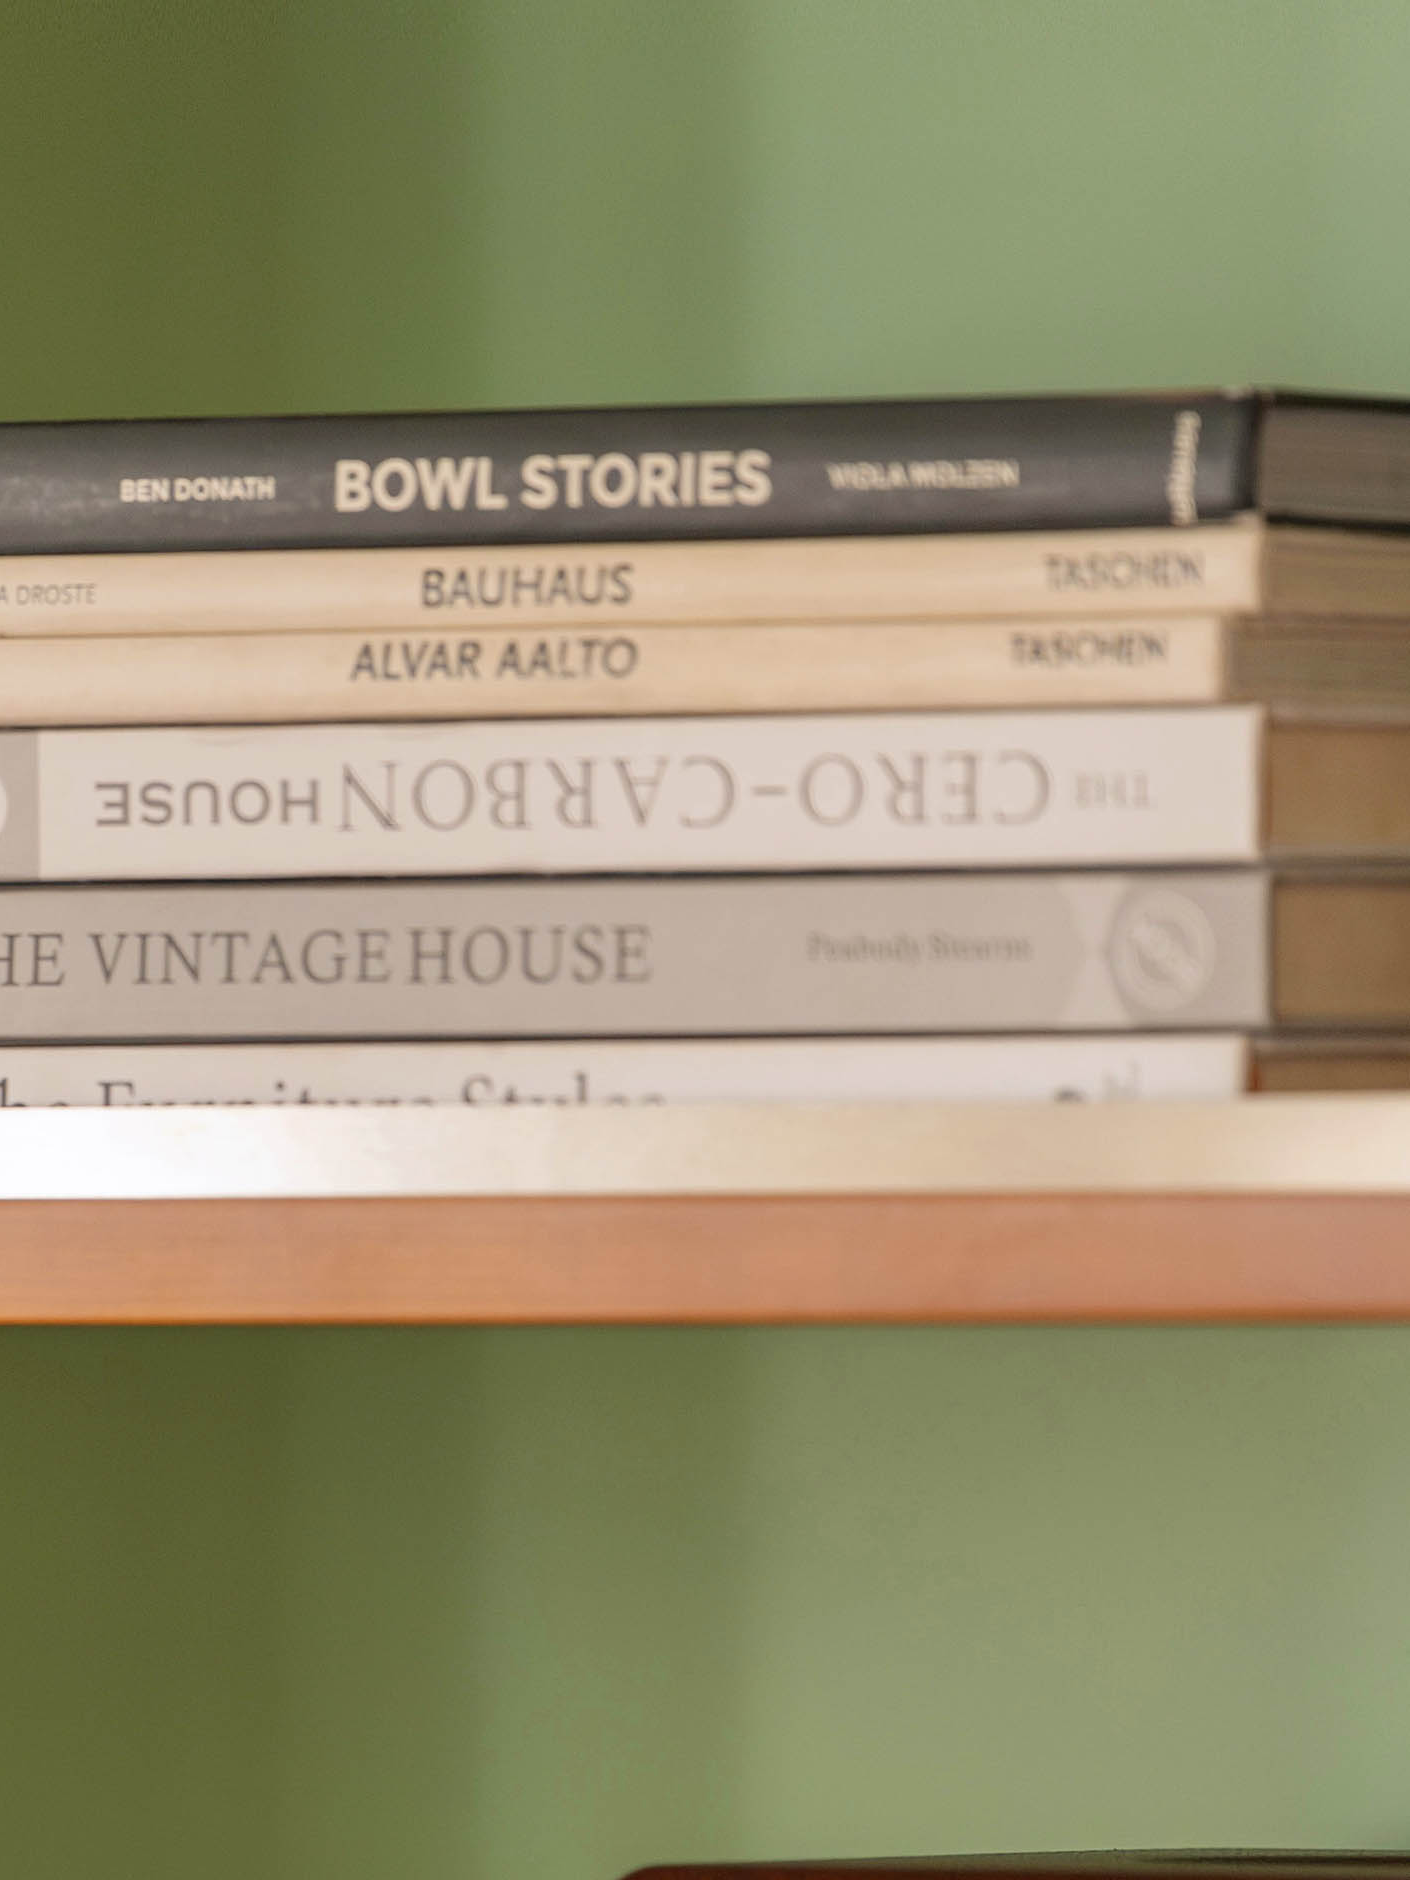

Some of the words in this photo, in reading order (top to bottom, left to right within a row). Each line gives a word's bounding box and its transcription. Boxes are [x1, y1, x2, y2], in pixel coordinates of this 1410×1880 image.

[119, 478, 170, 503] BEN
[173, 476, 276, 502] DONATH
[334, 457, 509, 513] BOWL
[520, 450, 772, 510] STORIES
[15, 582, 98, 606] DROSTE
[421, 562, 634, 609] BAUHAUS
[1044, 552, 1203, 591] TASCHEN
[350, 639, 483, 681] ALVAR
[497, 636, 639, 679] AALTO
[1010, 631, 1165, 665] TASCHEN
[94, 779, 319, 827] HOUSE
[88, 929, 391, 985] VINTAGE
[408, 924, 650, 985] HOUSE
